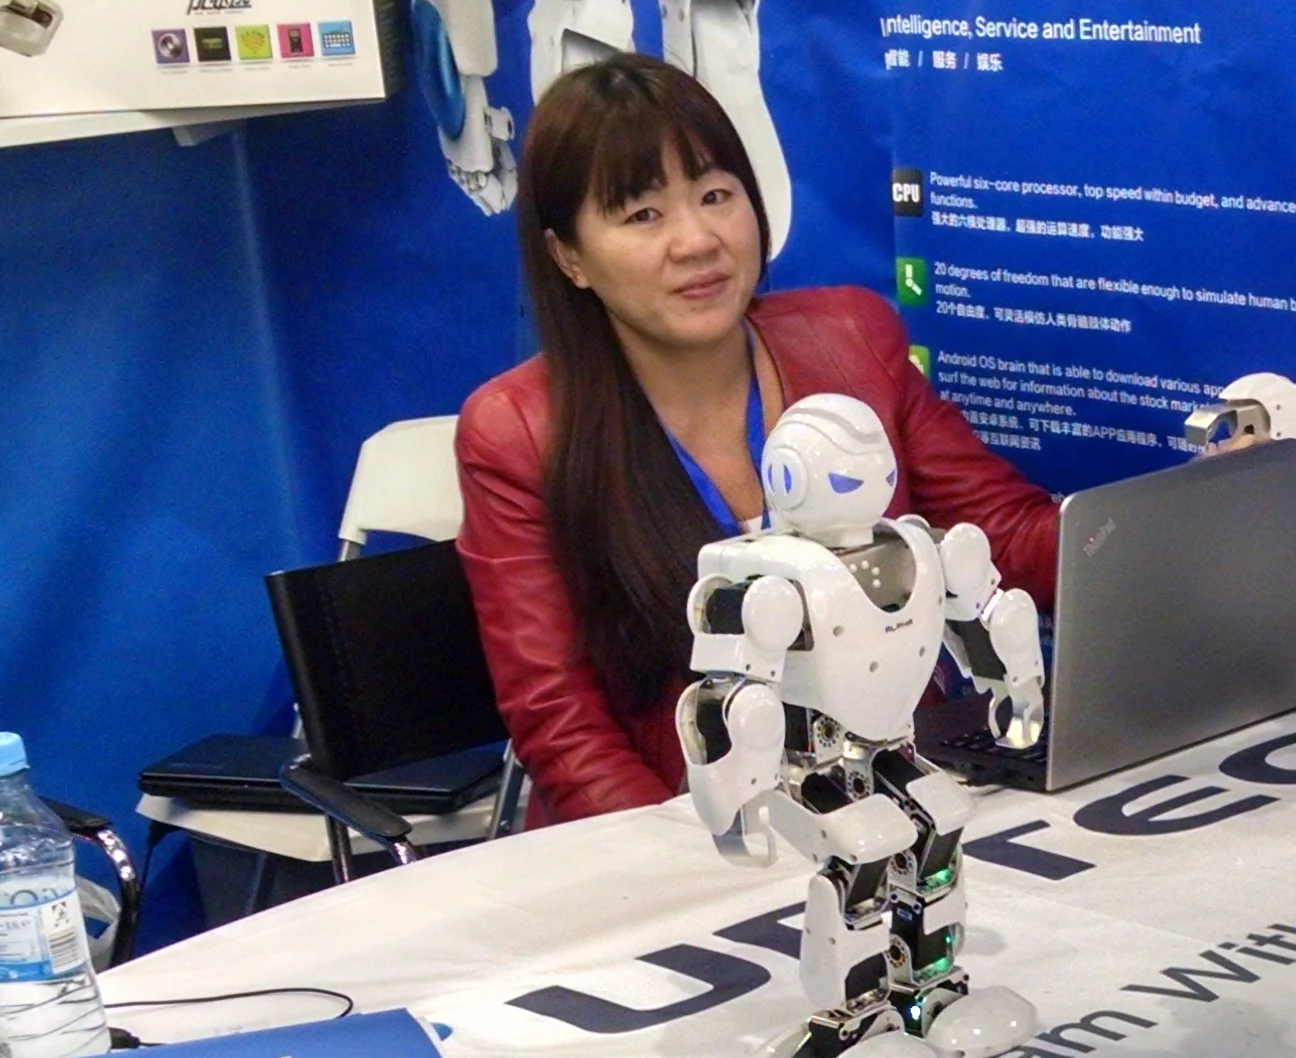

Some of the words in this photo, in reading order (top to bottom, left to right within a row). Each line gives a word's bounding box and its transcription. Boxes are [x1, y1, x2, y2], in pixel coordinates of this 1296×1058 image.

[975, 16, 1038, 39] Service
[1043, 18, 1075, 39] and
[1079, 18, 1201, 44] Entertainment
[892, 182, 920, 203] CPU
[930, 171, 972, 189] Powerful
[973, 176, 1019, 192] six-core
[1022, 181, 1082, 198] processor,
[1084, 184, 1103, 199] top
[1106, 186, 1142, 201] speed
[1144, 188, 1173, 203] within
[1175, 191, 1219, 209] budget,
[1221, 195, 1244, 209] and
[930, 192, 978, 208] functions.
[934, 261, 946, 276] 20
[949, 264, 989, 282] degrees
[990, 268, 1002, 281] of
[1003, 269, 1050, 286] freedom
[1051, 273, 1073, 288] that
[1076, 278, 1095, 290] are
[1098, 277, 1139, 295] flexible
[1141, 285, 1180, 301] enough
[1182, 286, 1193, 300] to
[1196, 288, 1246, 306] simulate
[1248, 291, 1288, 309] human
[935, 284, 971, 299] motion.
[938, 350, 976, 368] Android
[979, 355, 996, 370] OS
[998, 357, 1026, 373] brain
[1028, 361, 1051, 376] that
[1052, 363, 1062, 377] is
[1065, 365, 1090, 380] able
[1092, 368, 1104, 381] to
[1106, 369, 1157, 388] download
[1160, 378, 1201, 394] various
[938, 370, 958, 383] surf
[960, 373, 977, 386] the
[979, 375, 1000, 390] web
[1003, 377, 1017, 391] for
[1019, 379, 1085, 398] information
[1087, 388, 1118, 403] about
[1120, 391, 1137, 406] the
[1140, 395, 1169, 410] stock
[952, 392, 992, 407] anytime
[994, 397, 1014, 410] and
[1017, 399, 1077, 416] anywhere.
